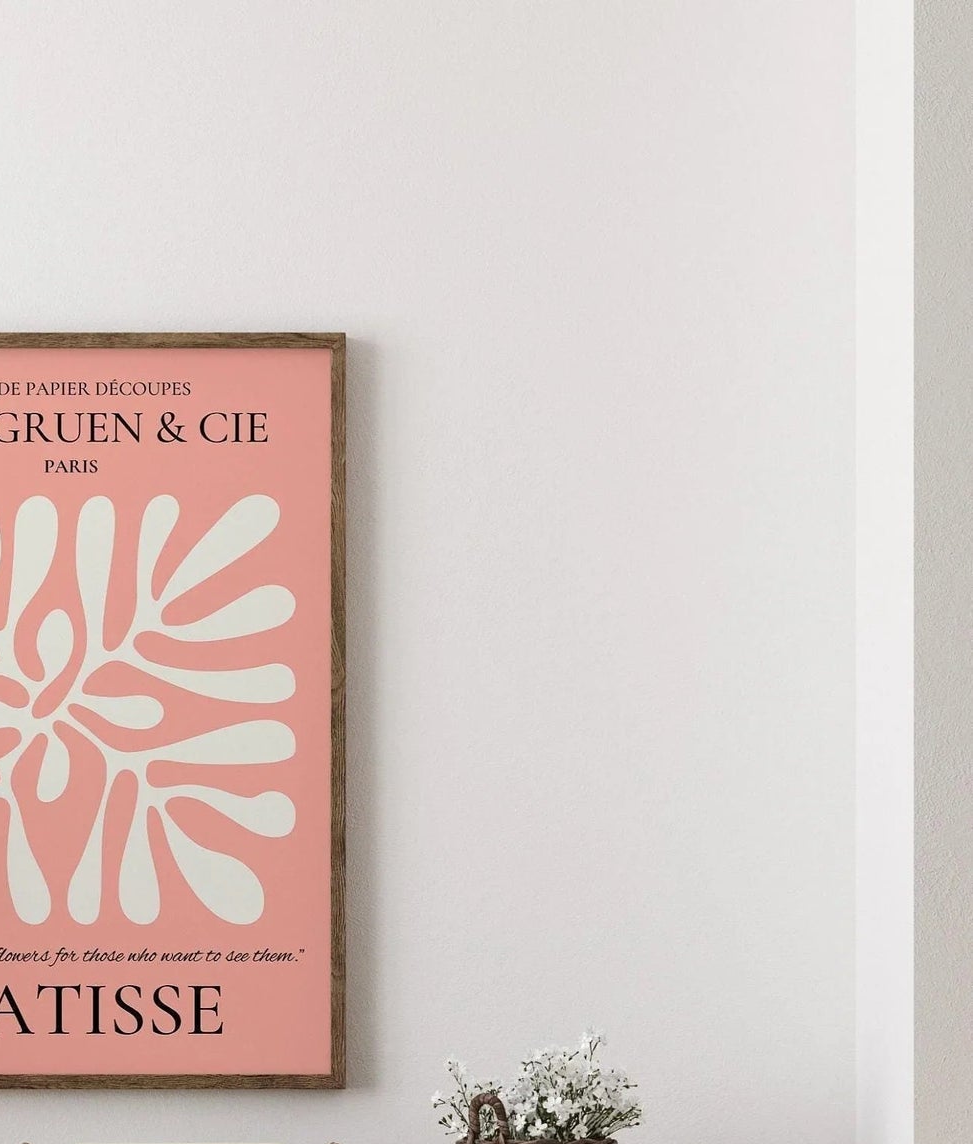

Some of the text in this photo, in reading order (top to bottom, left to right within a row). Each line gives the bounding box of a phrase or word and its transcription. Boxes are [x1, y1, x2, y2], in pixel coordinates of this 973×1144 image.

[26, 381, 91, 396] PAPIER
[95, 378, 191, 396] DÉCOUPES
[156, 411, 188, 444] &
[199, 411, 269, 444] CIE
[44, 459, 99, 474] PARIS
[49, 946, 80, 967] for
[82, 947, 126, 963] those
[127, 947, 158, 962] who
[160, 949, 204, 963] want
[205, 949, 222, 962] to
[225, 950, 251, 963] see
